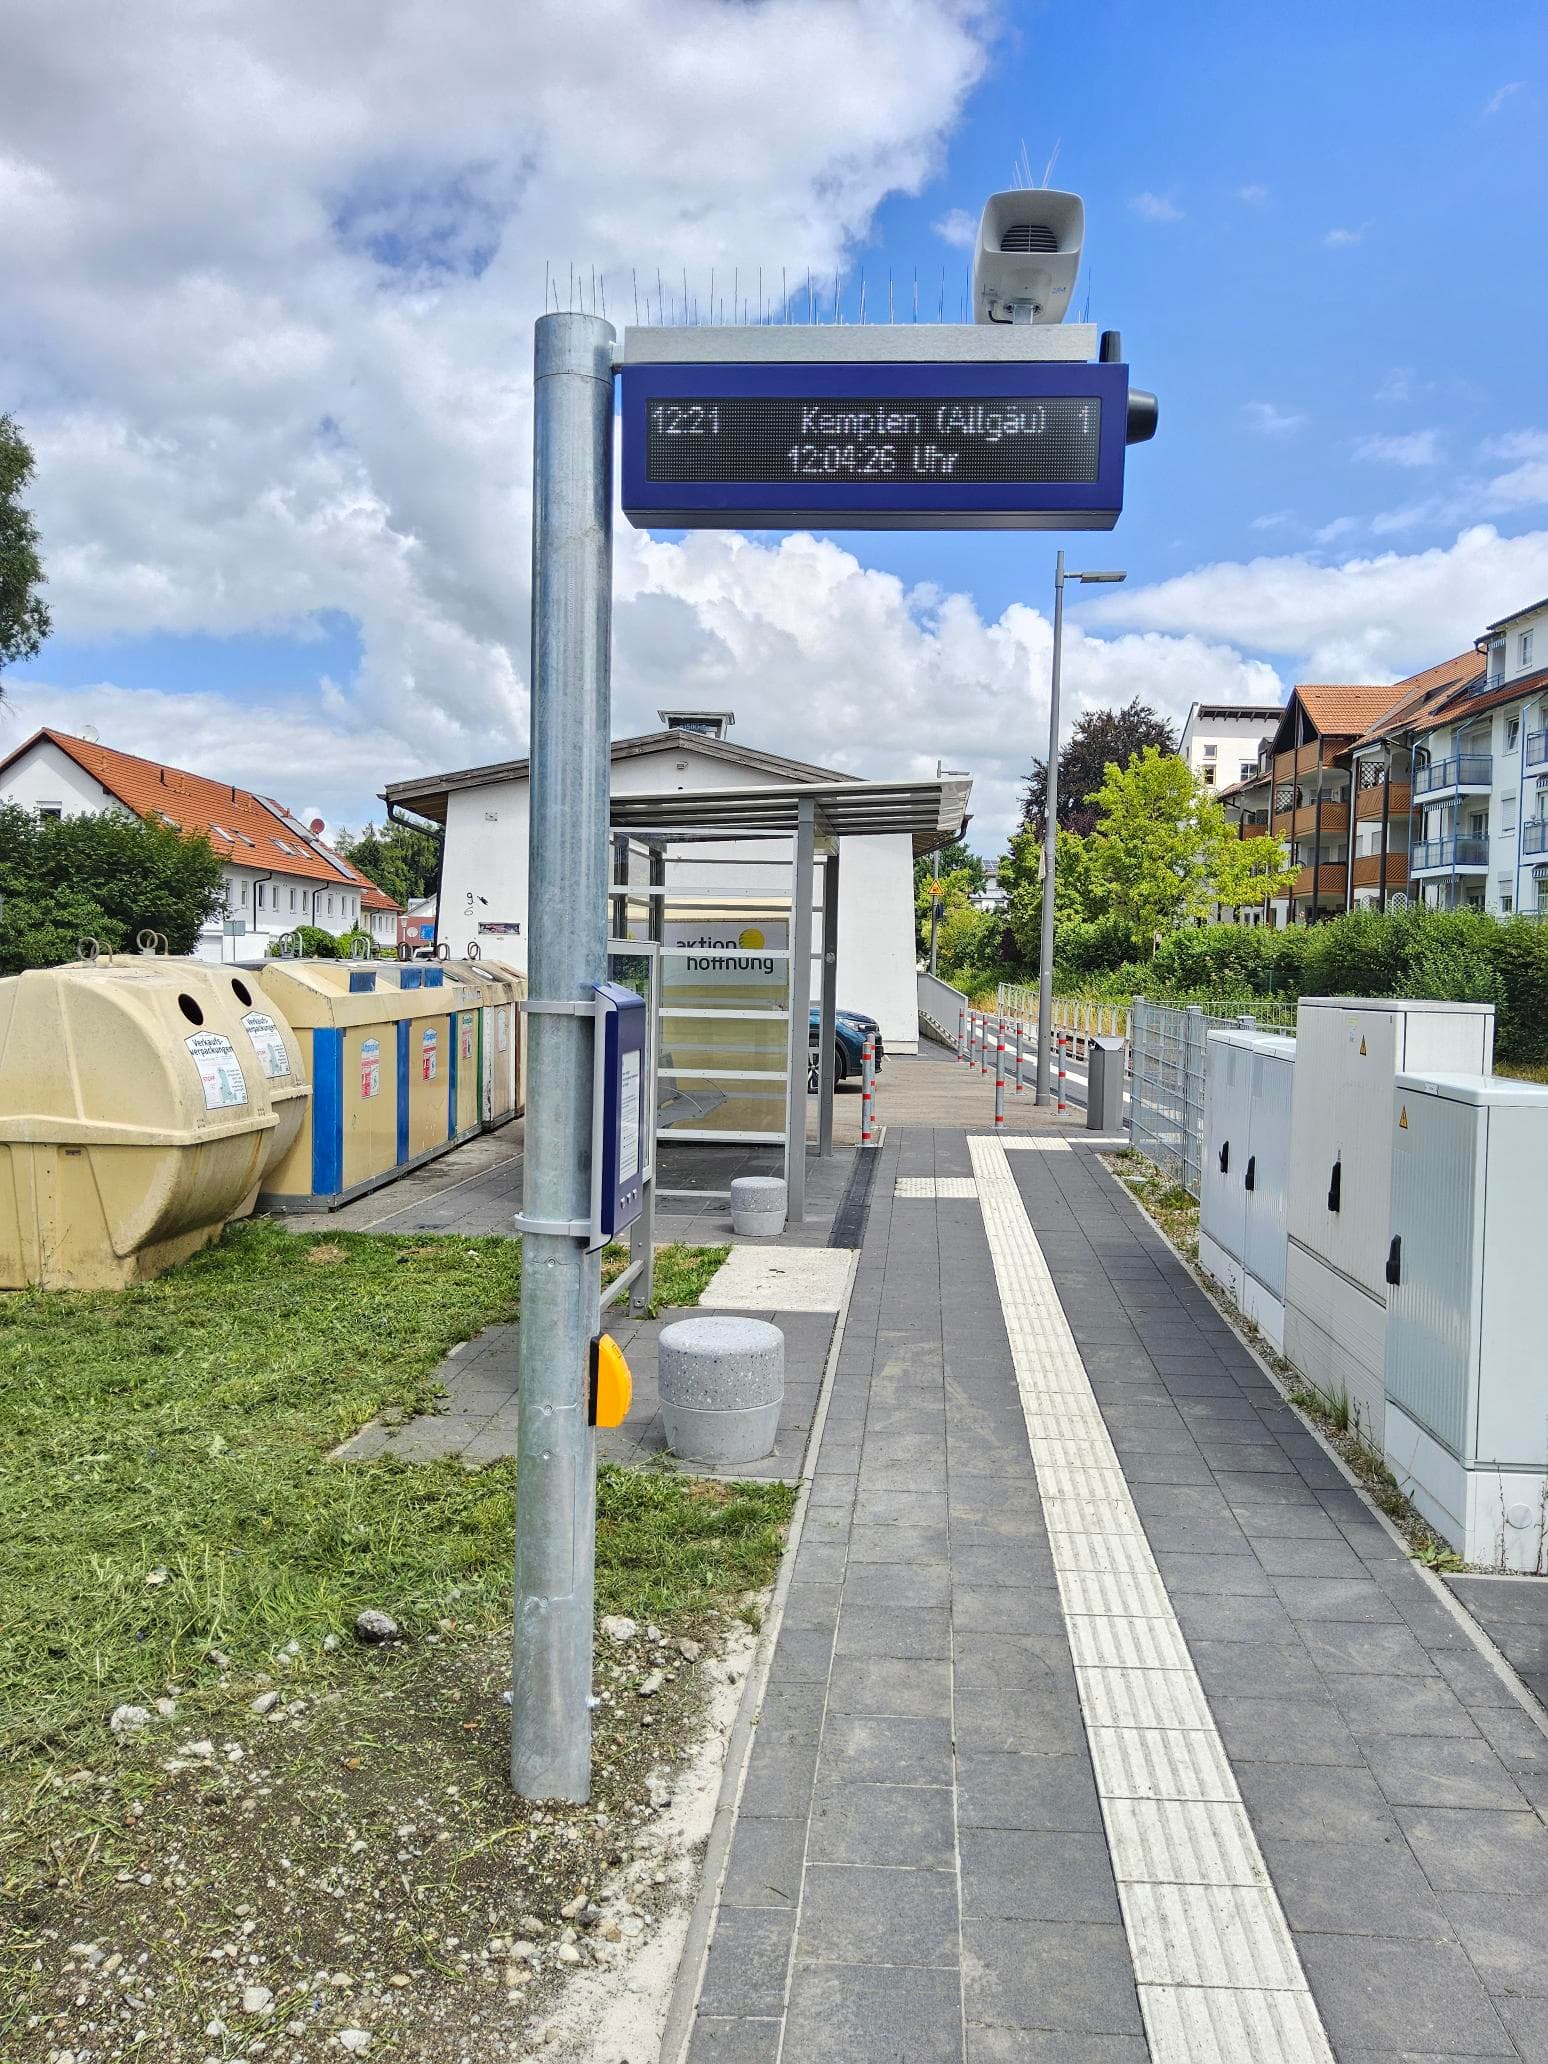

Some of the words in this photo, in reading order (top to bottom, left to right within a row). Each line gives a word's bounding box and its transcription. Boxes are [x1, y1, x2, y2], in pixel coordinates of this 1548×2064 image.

[802, 406, 921, 441] Kempten
[936, 406, 1046, 442] (Allgäu)
[1079, 405, 1089, 433] 1
[787, 445, 896, 473] 12:04:26
[912, 445, 959, 473] Uhr
[191, 1035, 224, 1047] Verkaufs-
[189, 1046, 234, 1058] verpackungen
